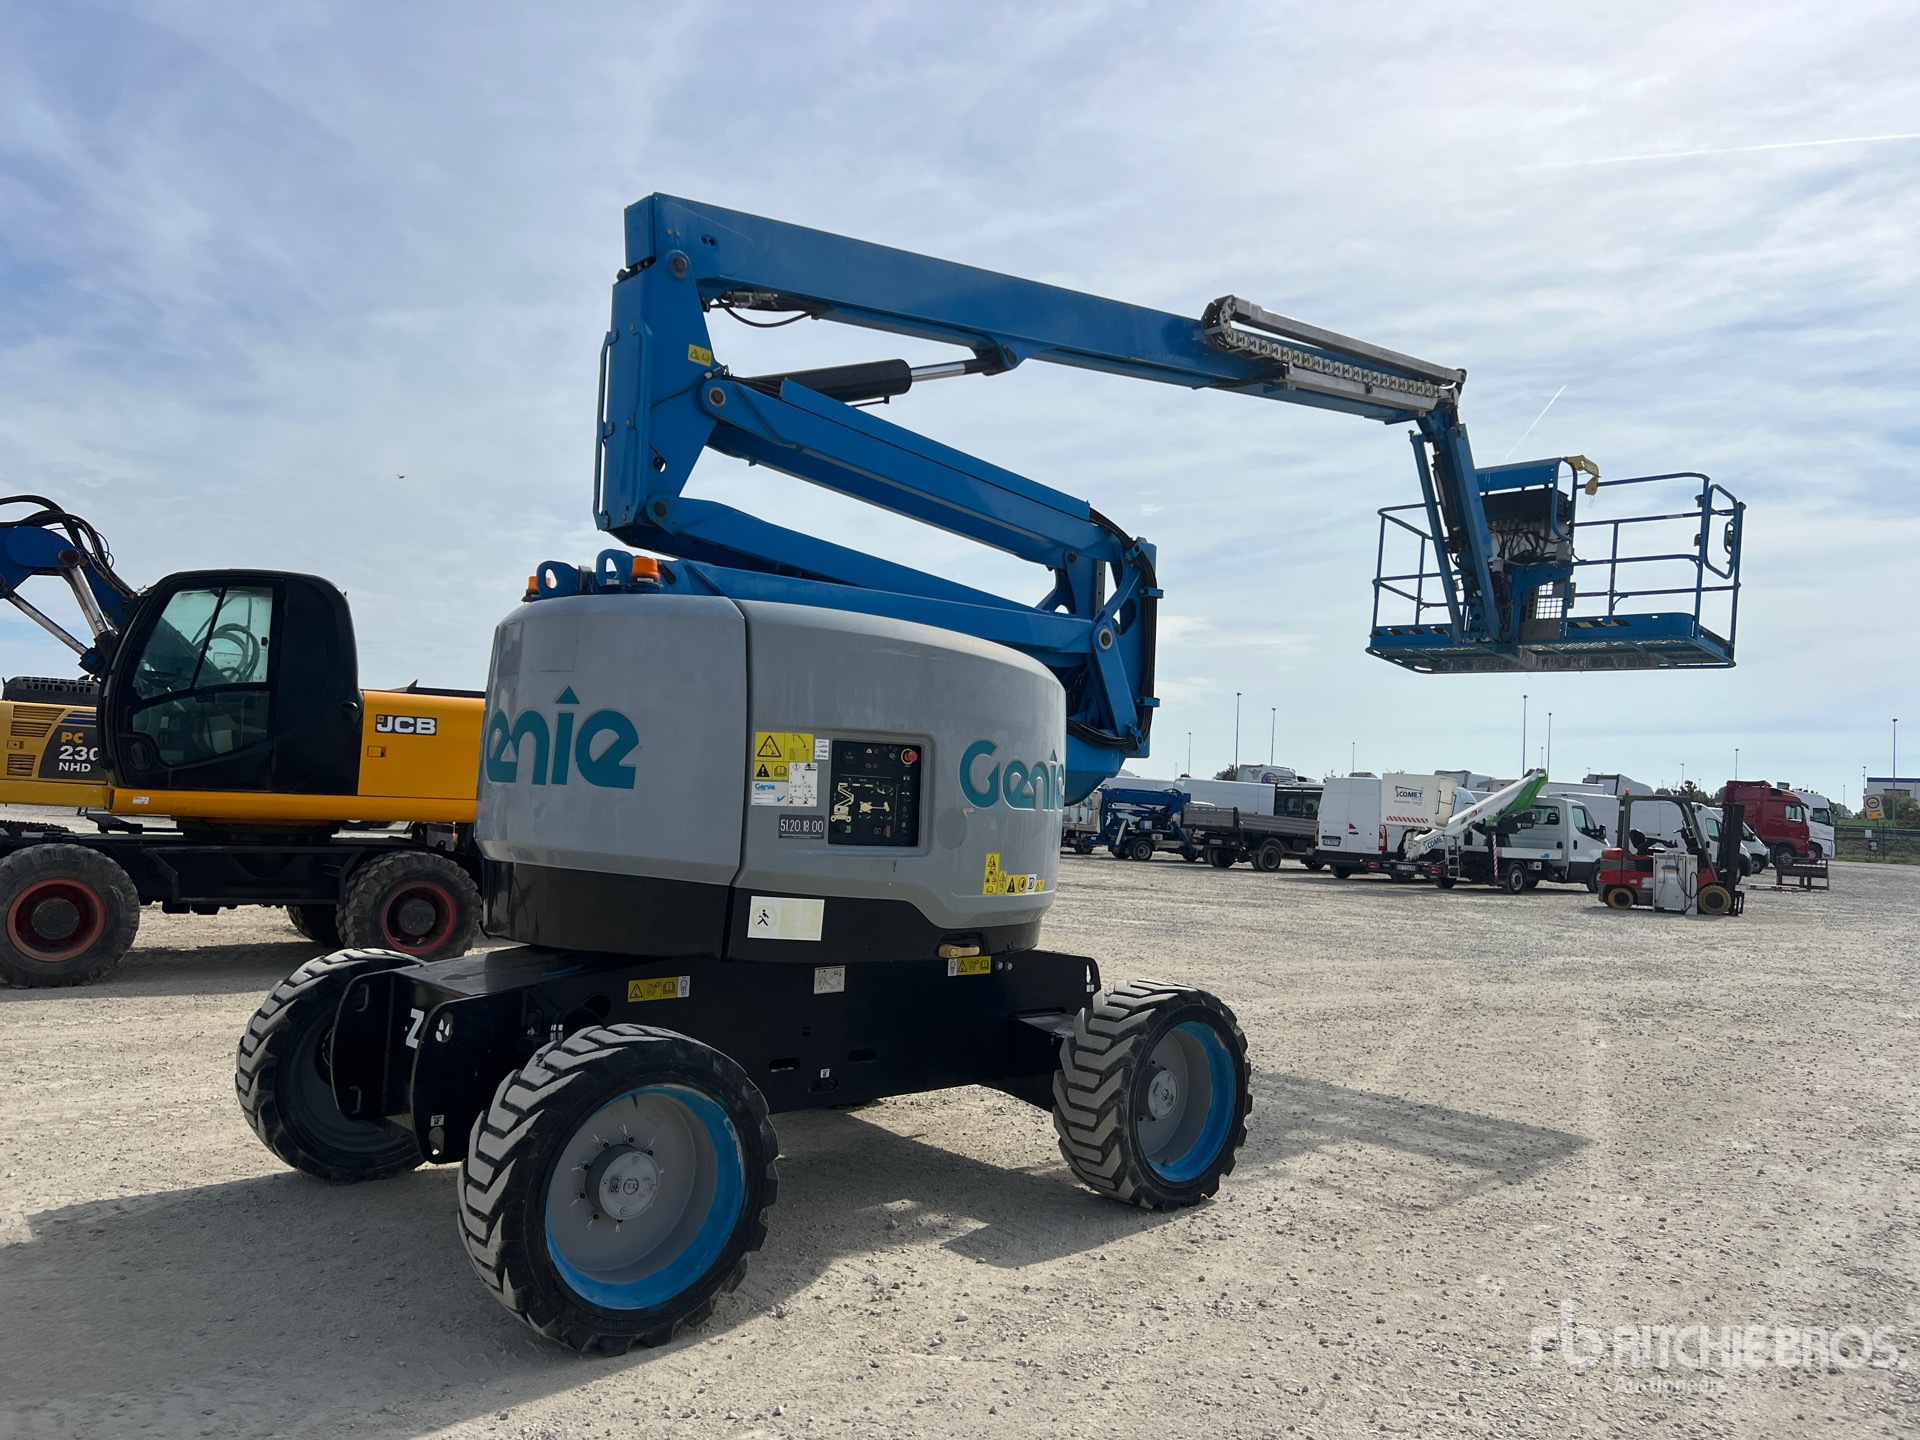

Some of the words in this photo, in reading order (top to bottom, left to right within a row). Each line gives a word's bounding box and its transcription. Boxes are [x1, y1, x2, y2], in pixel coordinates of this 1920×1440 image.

[376, 715, 436, 735] JCB
[60, 731, 84, 744] PC
[486, 685, 640, 790] enie
[58, 762, 92, 772] NHD
[959, 738, 1065, 811] Genie
[754, 782, 776, 791] Genie
[1398, 790, 1424, 798] COMET
[1427, 836, 1444, 849] COME
